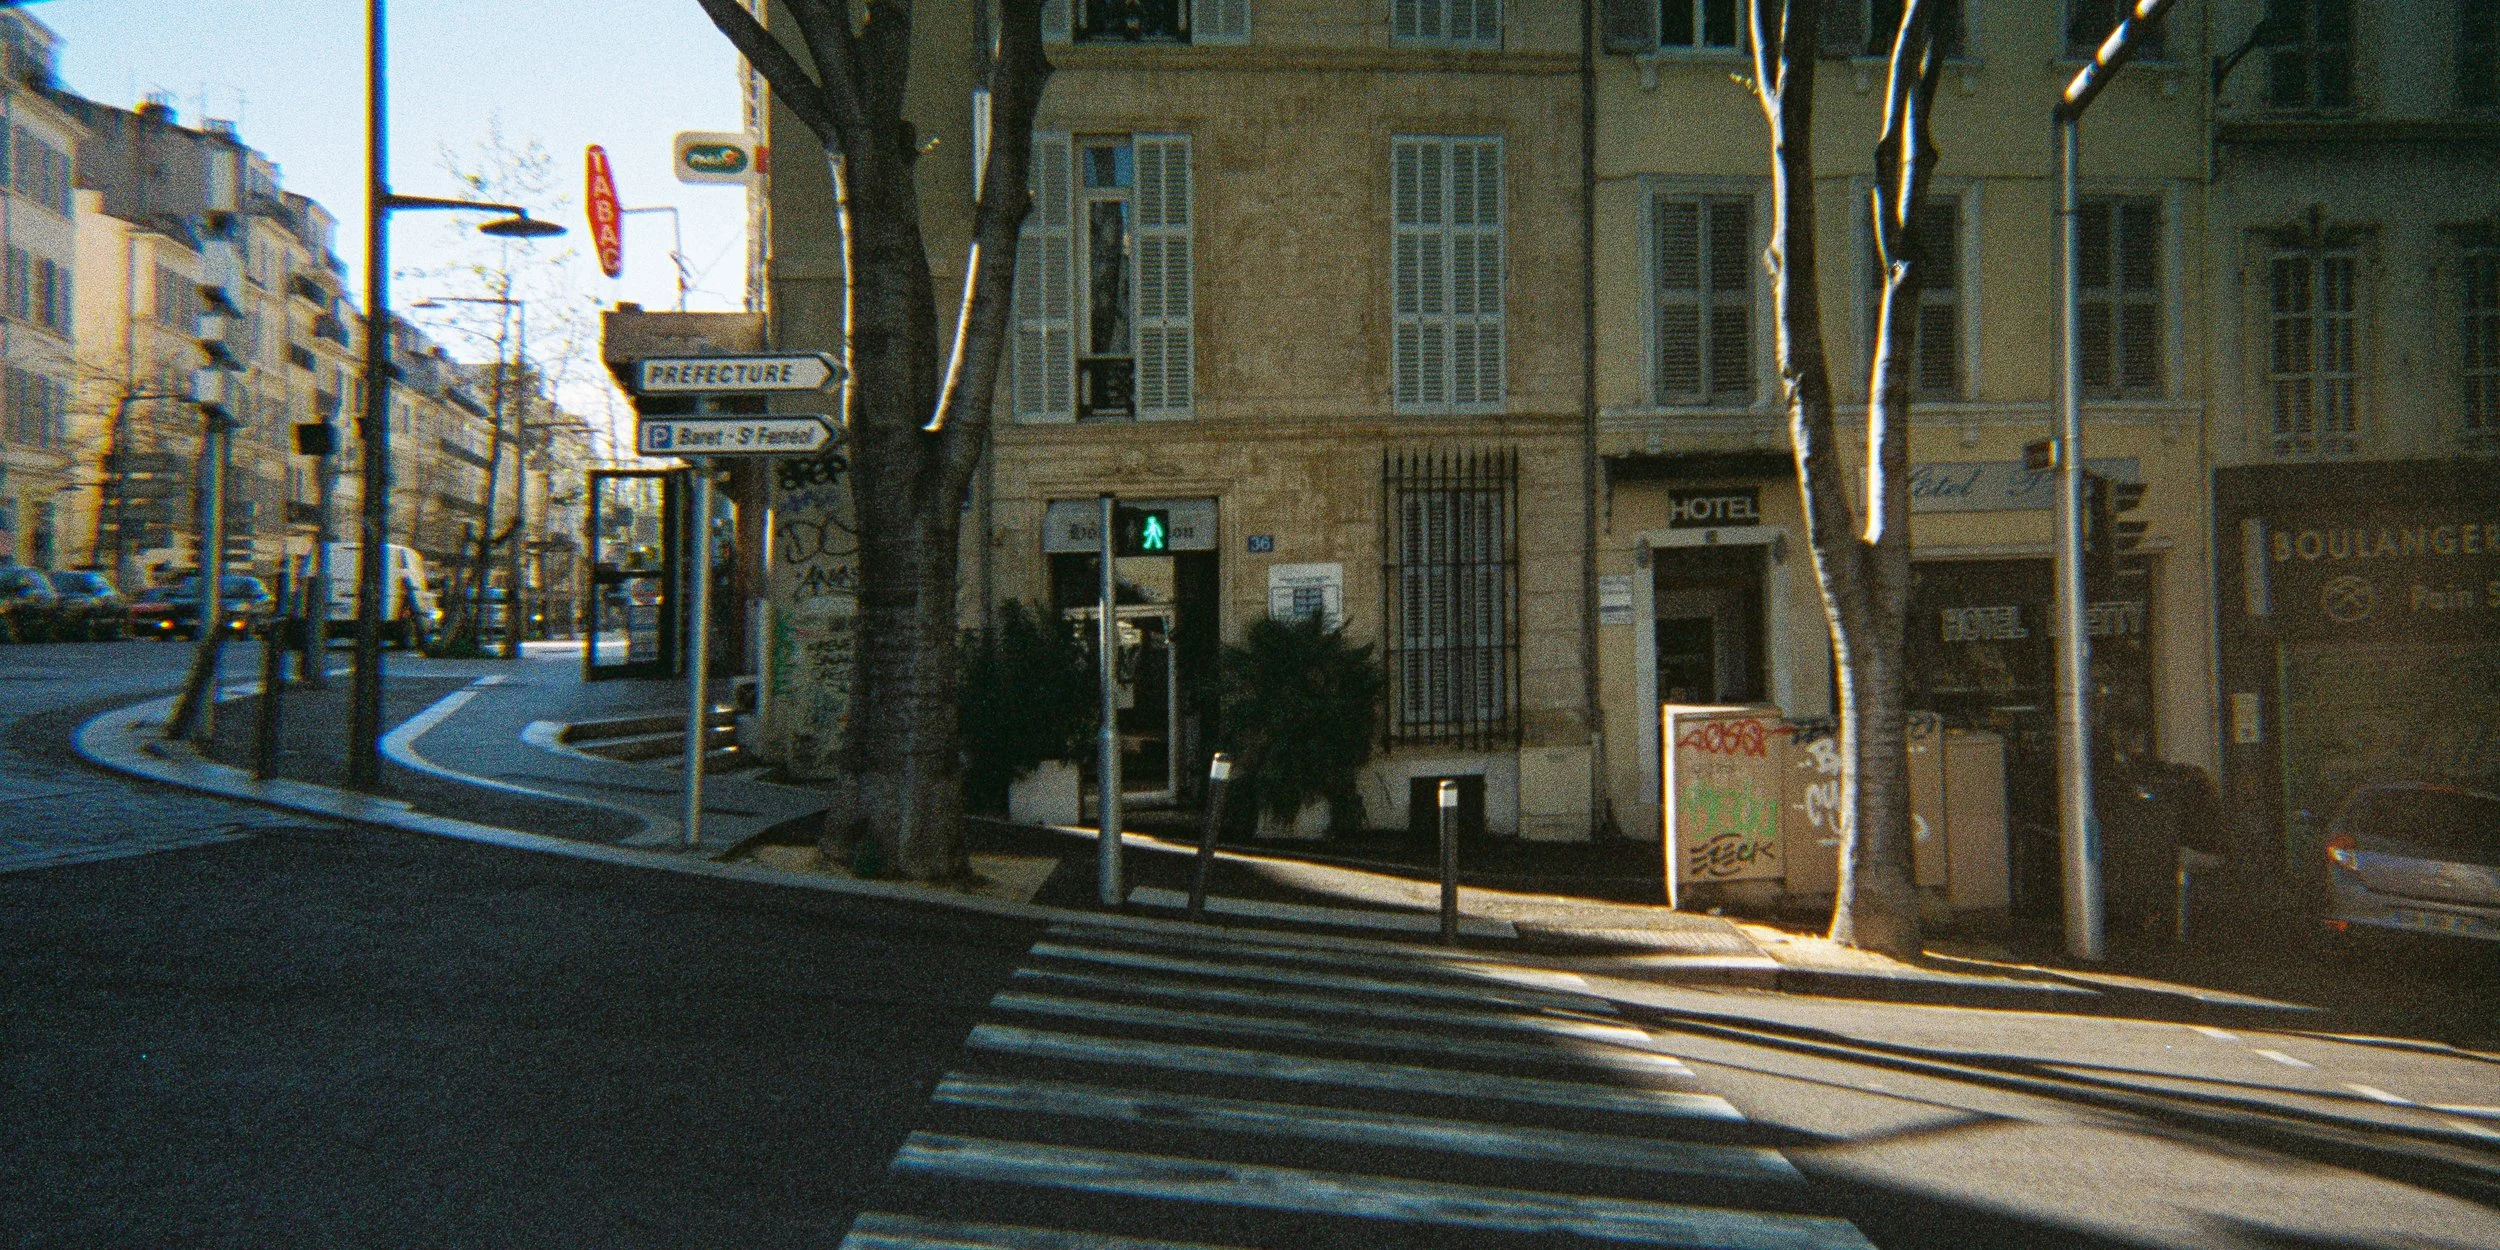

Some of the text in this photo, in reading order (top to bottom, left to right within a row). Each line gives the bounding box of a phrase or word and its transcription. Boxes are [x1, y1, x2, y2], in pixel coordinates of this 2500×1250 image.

[590, 150, 621, 272] TABAC
[677, 427, 724, 446] Baret
[1671, 496, 1760, 520] HOTEL
[1250, 535, 1271, 551] 36
[2409, 582, 2475, 612] Pain
[1942, 606, 2029, 642] HOTEL
